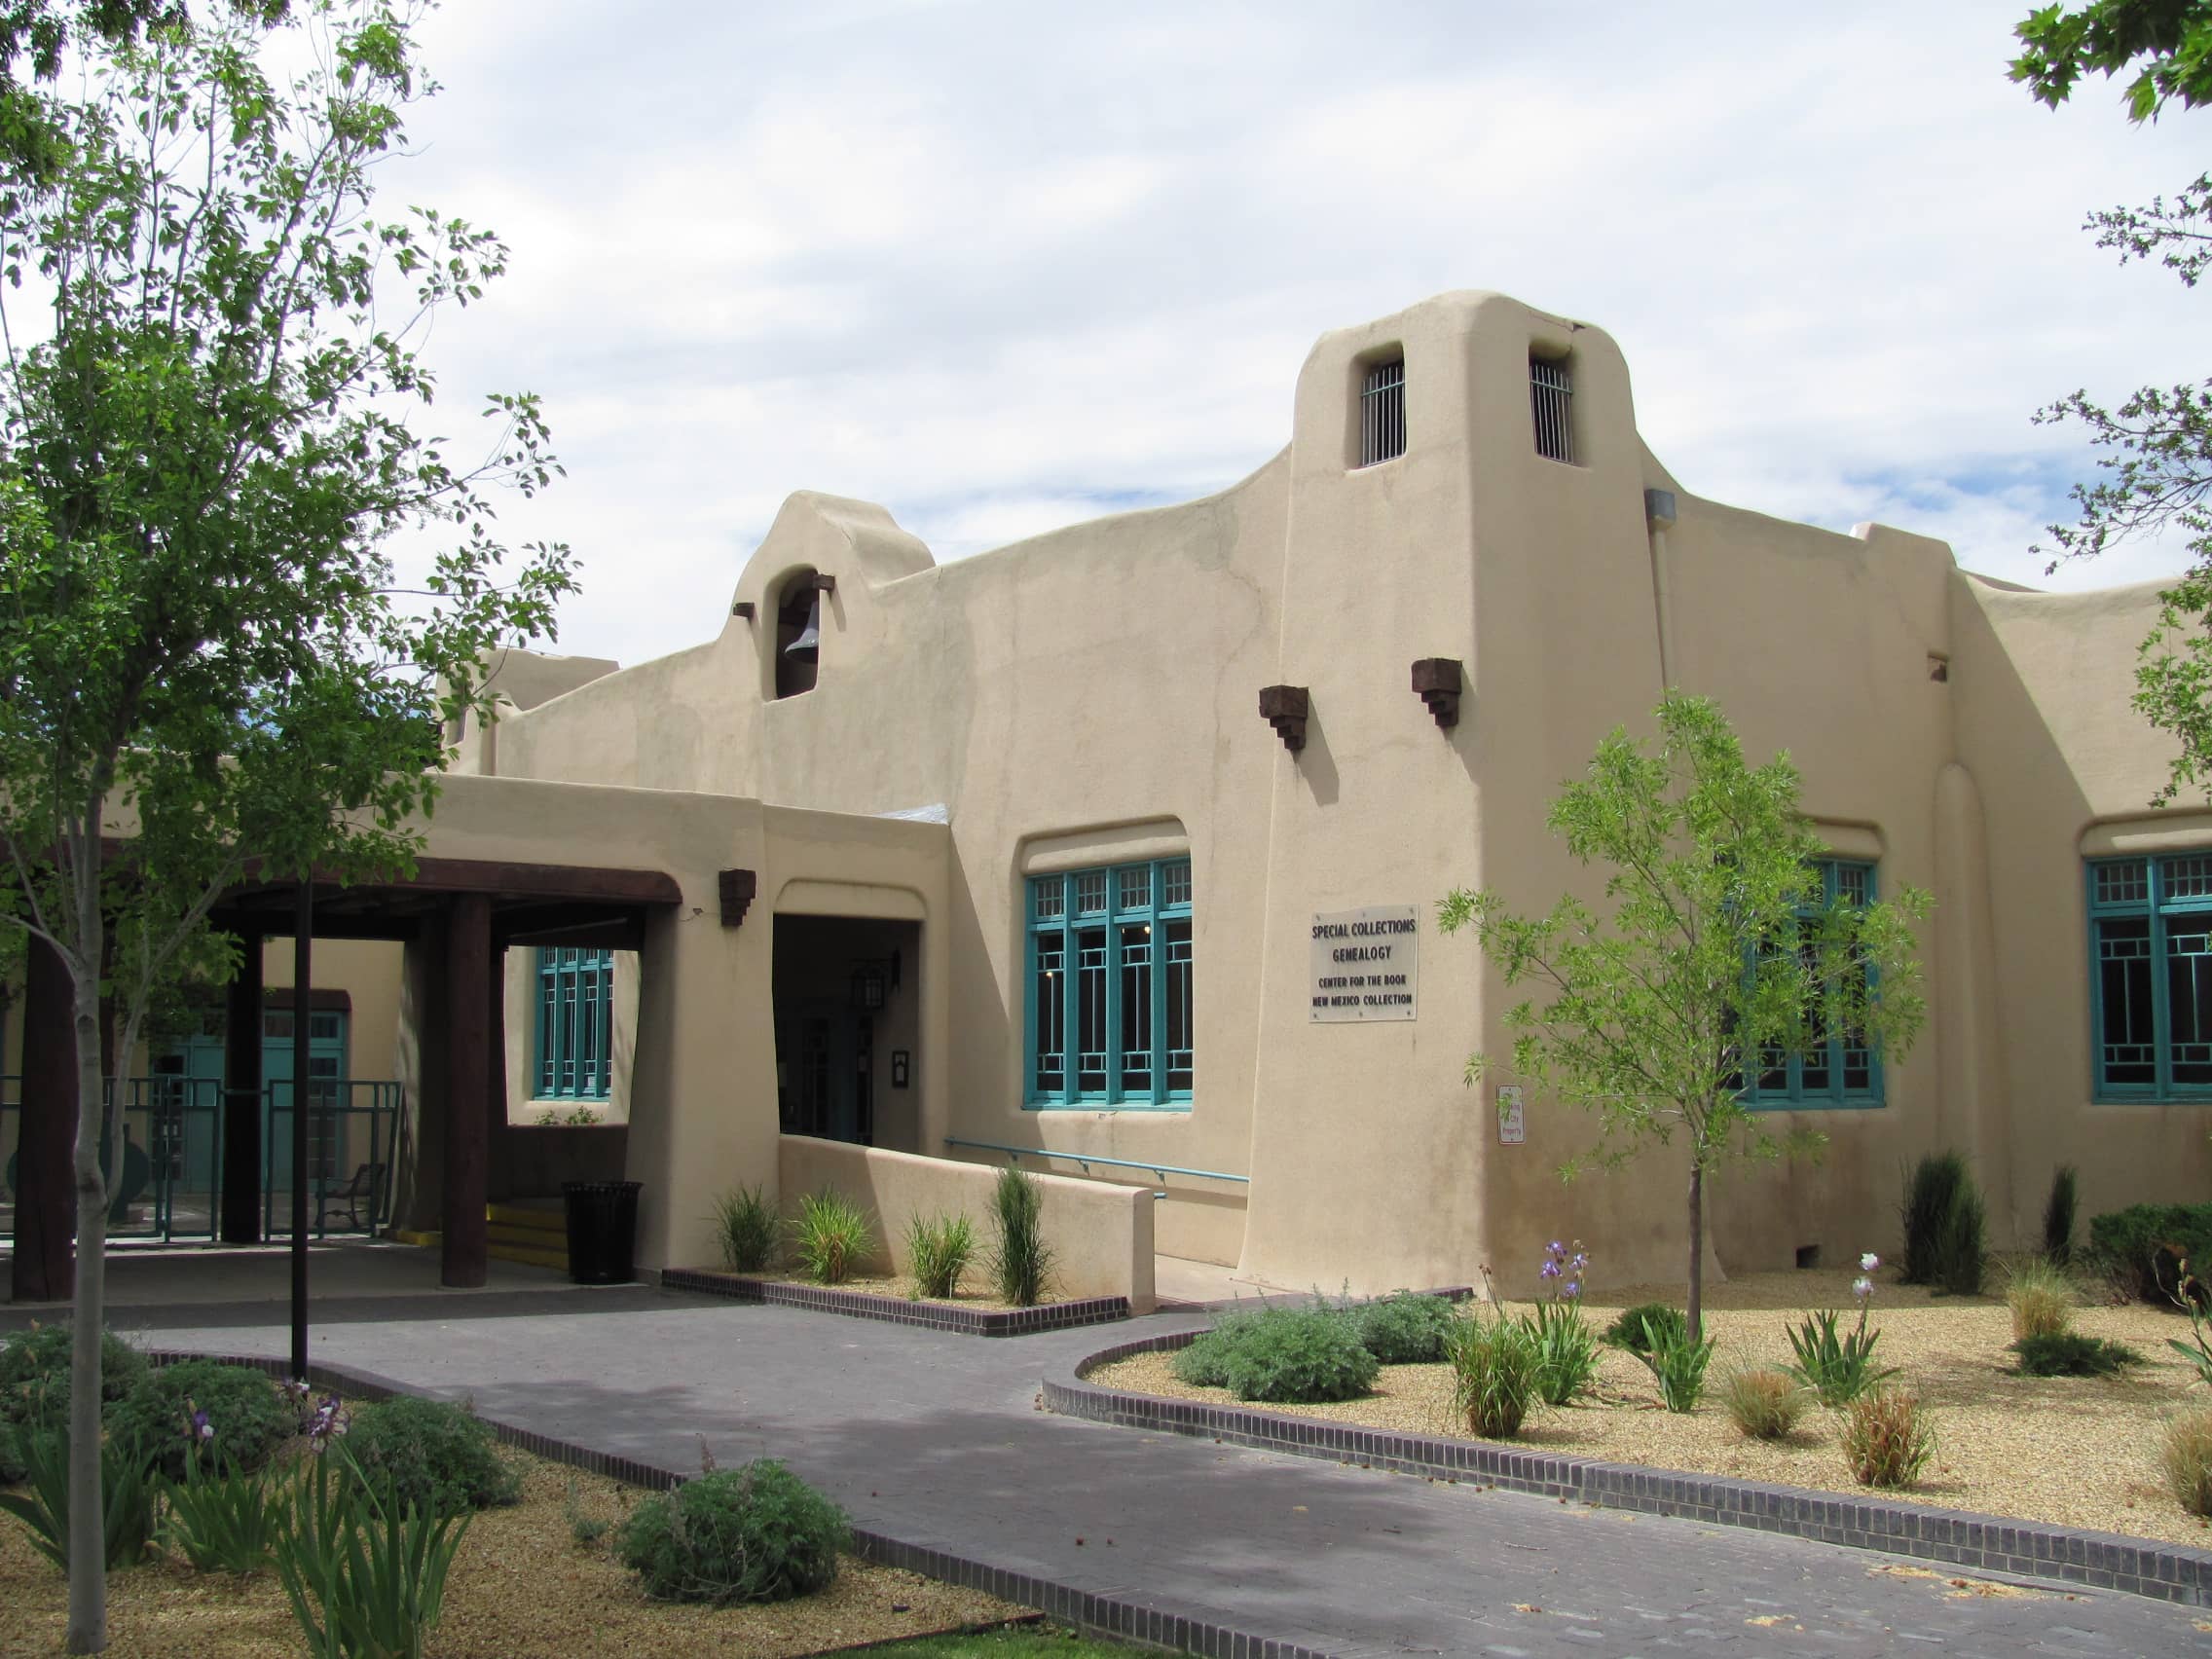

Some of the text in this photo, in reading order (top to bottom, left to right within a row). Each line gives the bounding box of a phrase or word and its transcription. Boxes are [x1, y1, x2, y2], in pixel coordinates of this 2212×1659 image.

[1312, 918, 1416, 940] SPECIAL COLLECTIONS
[1332, 944, 1391, 963] GENEALOGY
[1318, 974, 1407, 989] CENTER FOR THE BOOK
[1312, 993, 1412, 1007] NEW MEXICO COLLECTION
